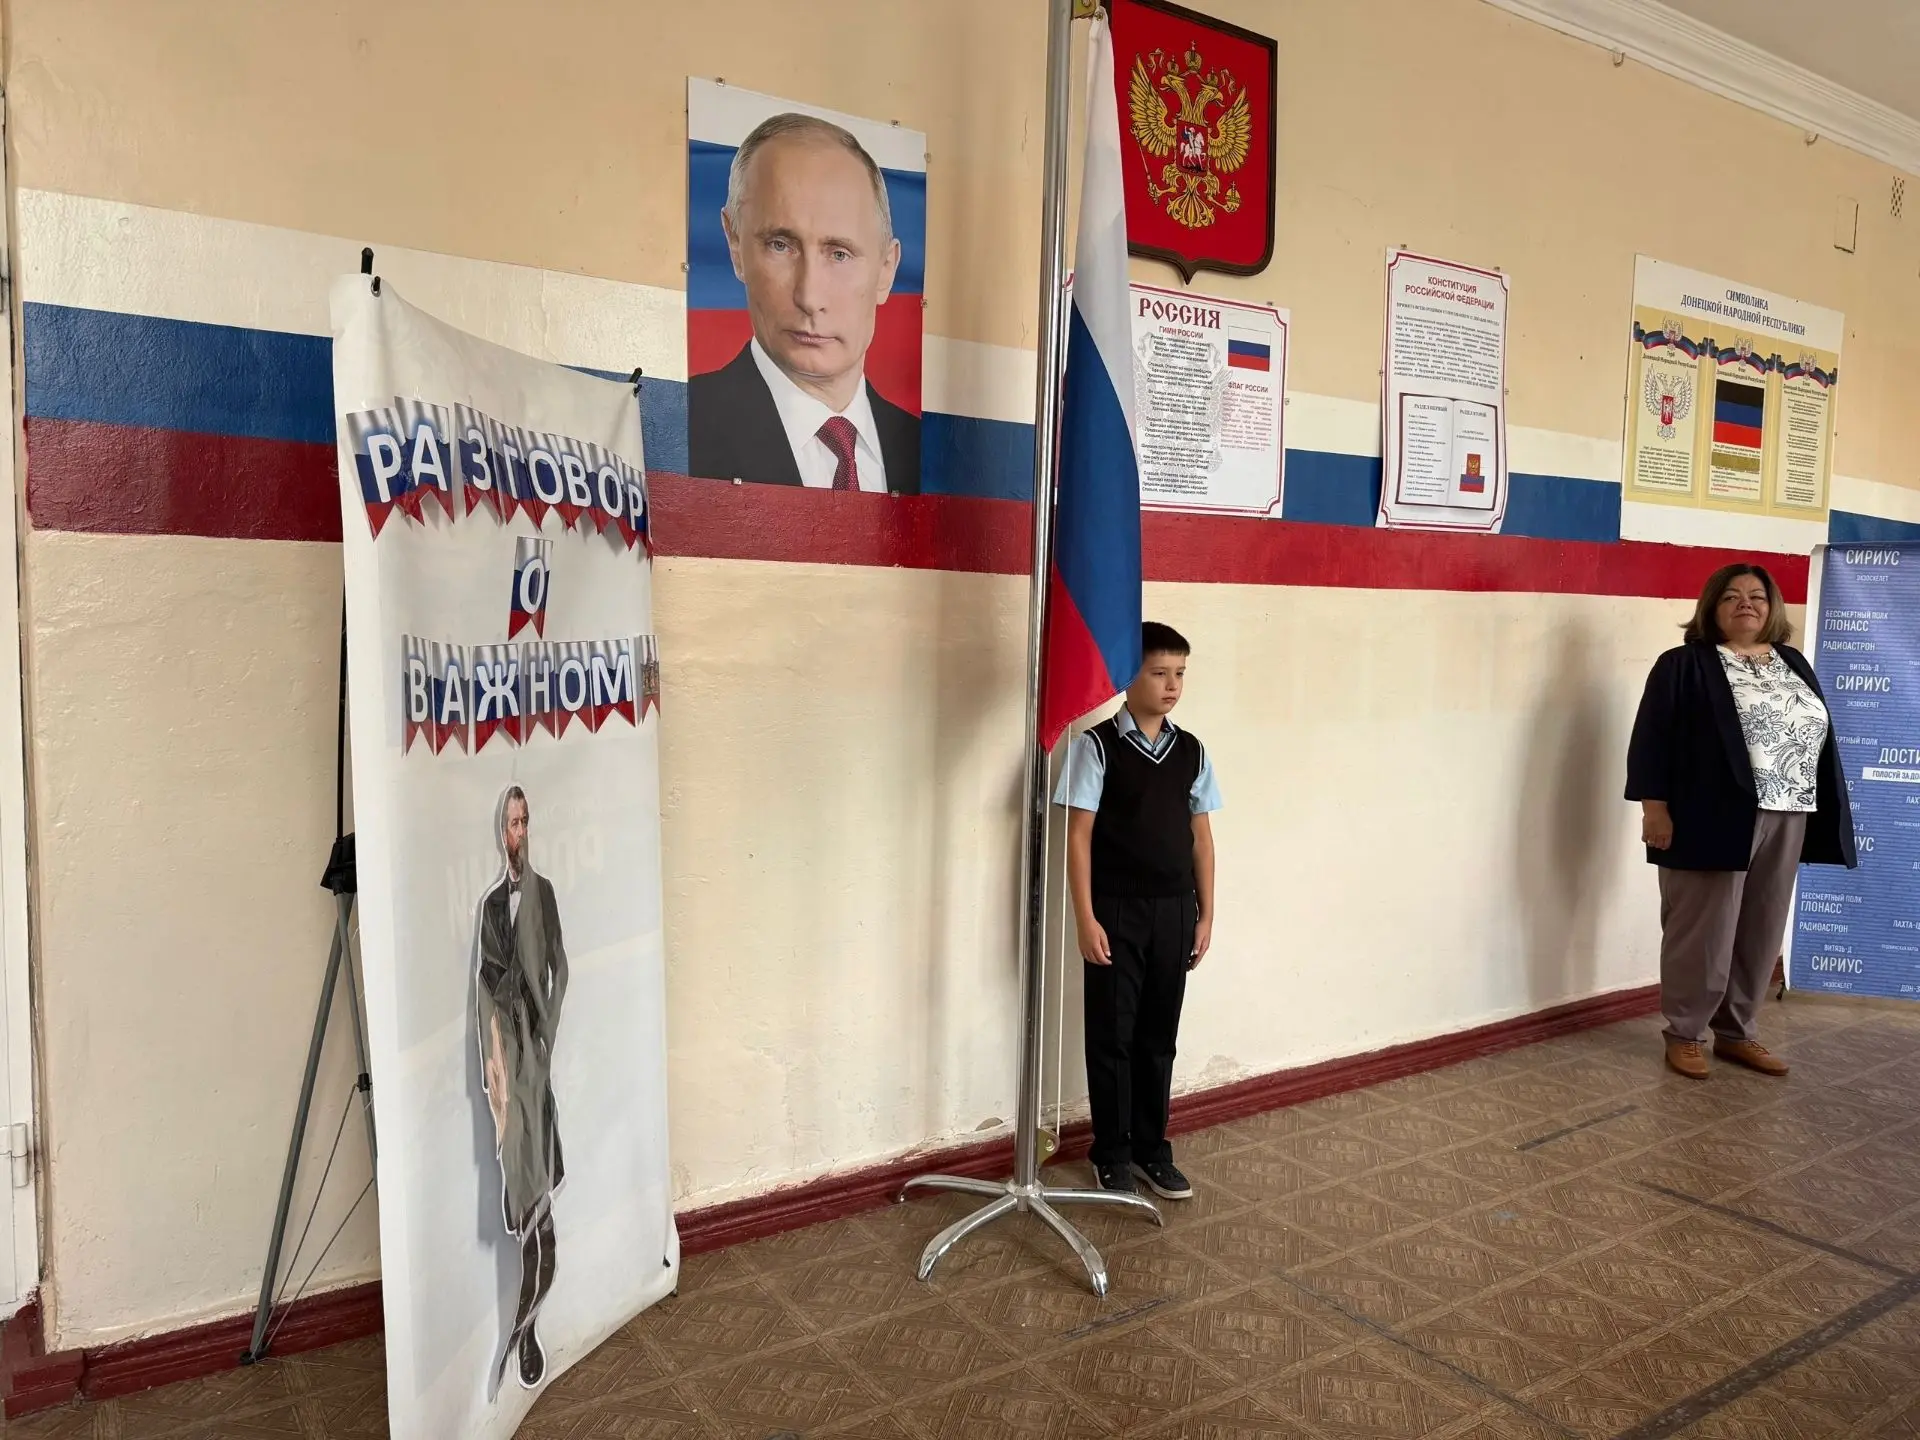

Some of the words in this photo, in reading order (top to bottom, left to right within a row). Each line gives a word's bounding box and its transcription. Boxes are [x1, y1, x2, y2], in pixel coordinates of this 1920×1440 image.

[1427, 276, 1477, 294] КОНСТИТУЦИЯ
[1405, 284, 1455, 300] РОССИЙСКОЙ
[1456, 294, 1495, 310] ФЕДЕРАЦИИ
[1725, 289, 1769, 310] СИМВОЛИКА
[1138, 297, 1221, 330] РОССИЯ
[1680, 294, 1722, 315] ДОНЕЦКОЙ
[1723, 305, 1761, 323] НАРОДНОЙ
[1762, 315, 1805, 336] РЕСПУБЛИКИ
[1159, 325, 1177, 336] ГИМН
[1178, 328, 1204, 339] РОССИИ
[1228, 381, 1244, 390] ФЛАГ
[1245, 384, 1269, 392] РОССИИ
[367, 424, 644, 530] РАЗГОВОР
[1846, 549, 1900, 566] СИРИУС
[1825, 609, 1871, 619] БЕССМЕРТНЫЙ
[1871, 611, 1888, 620] ПОЛК
[1824, 619, 1869, 632] ГЛОНАСС
[1822, 640, 1876, 651] РАДИОАСТРОН
[1849, 663, 1880, 672] ВИТЯЗЬ-Д
[409, 654, 633, 725] ВАЖНОМ
[1836, 675, 1891, 693] СИРИУС
[1835, 735, 1860, 745] ЕРТНЫЙ
[1861, 737, 1878, 746] ПОЛК
[1872, 769, 1900, 777] ГОЛОСУЙ
[1801, 892, 1845, 902] БЕССМЕРТНЫЙ
[1845, 895, 1863, 903] ПОЛК
[1800, 901, 1842, 914] ГЛОНАСС
[1799, 921, 1849, 933] РАДИОАСТРОН
[1811, 955, 1863, 974] СИРИУС
